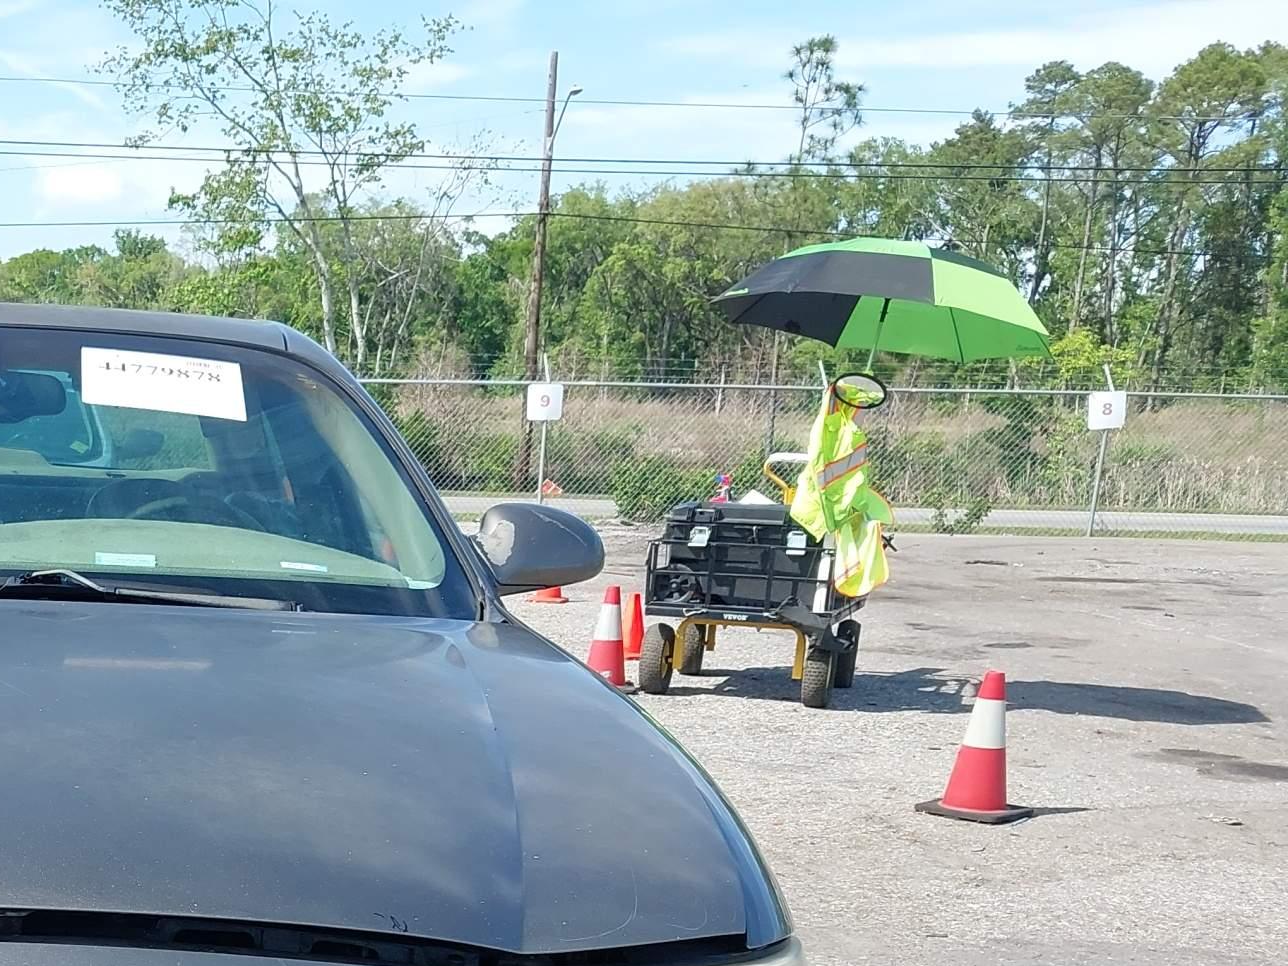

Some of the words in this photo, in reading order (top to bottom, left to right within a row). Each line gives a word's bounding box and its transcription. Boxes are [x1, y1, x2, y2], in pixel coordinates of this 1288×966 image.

[98, 361, 221, 383] 44779878
[540, 394, 551, 408] 9
[1102, 402, 1113, 416] 8
